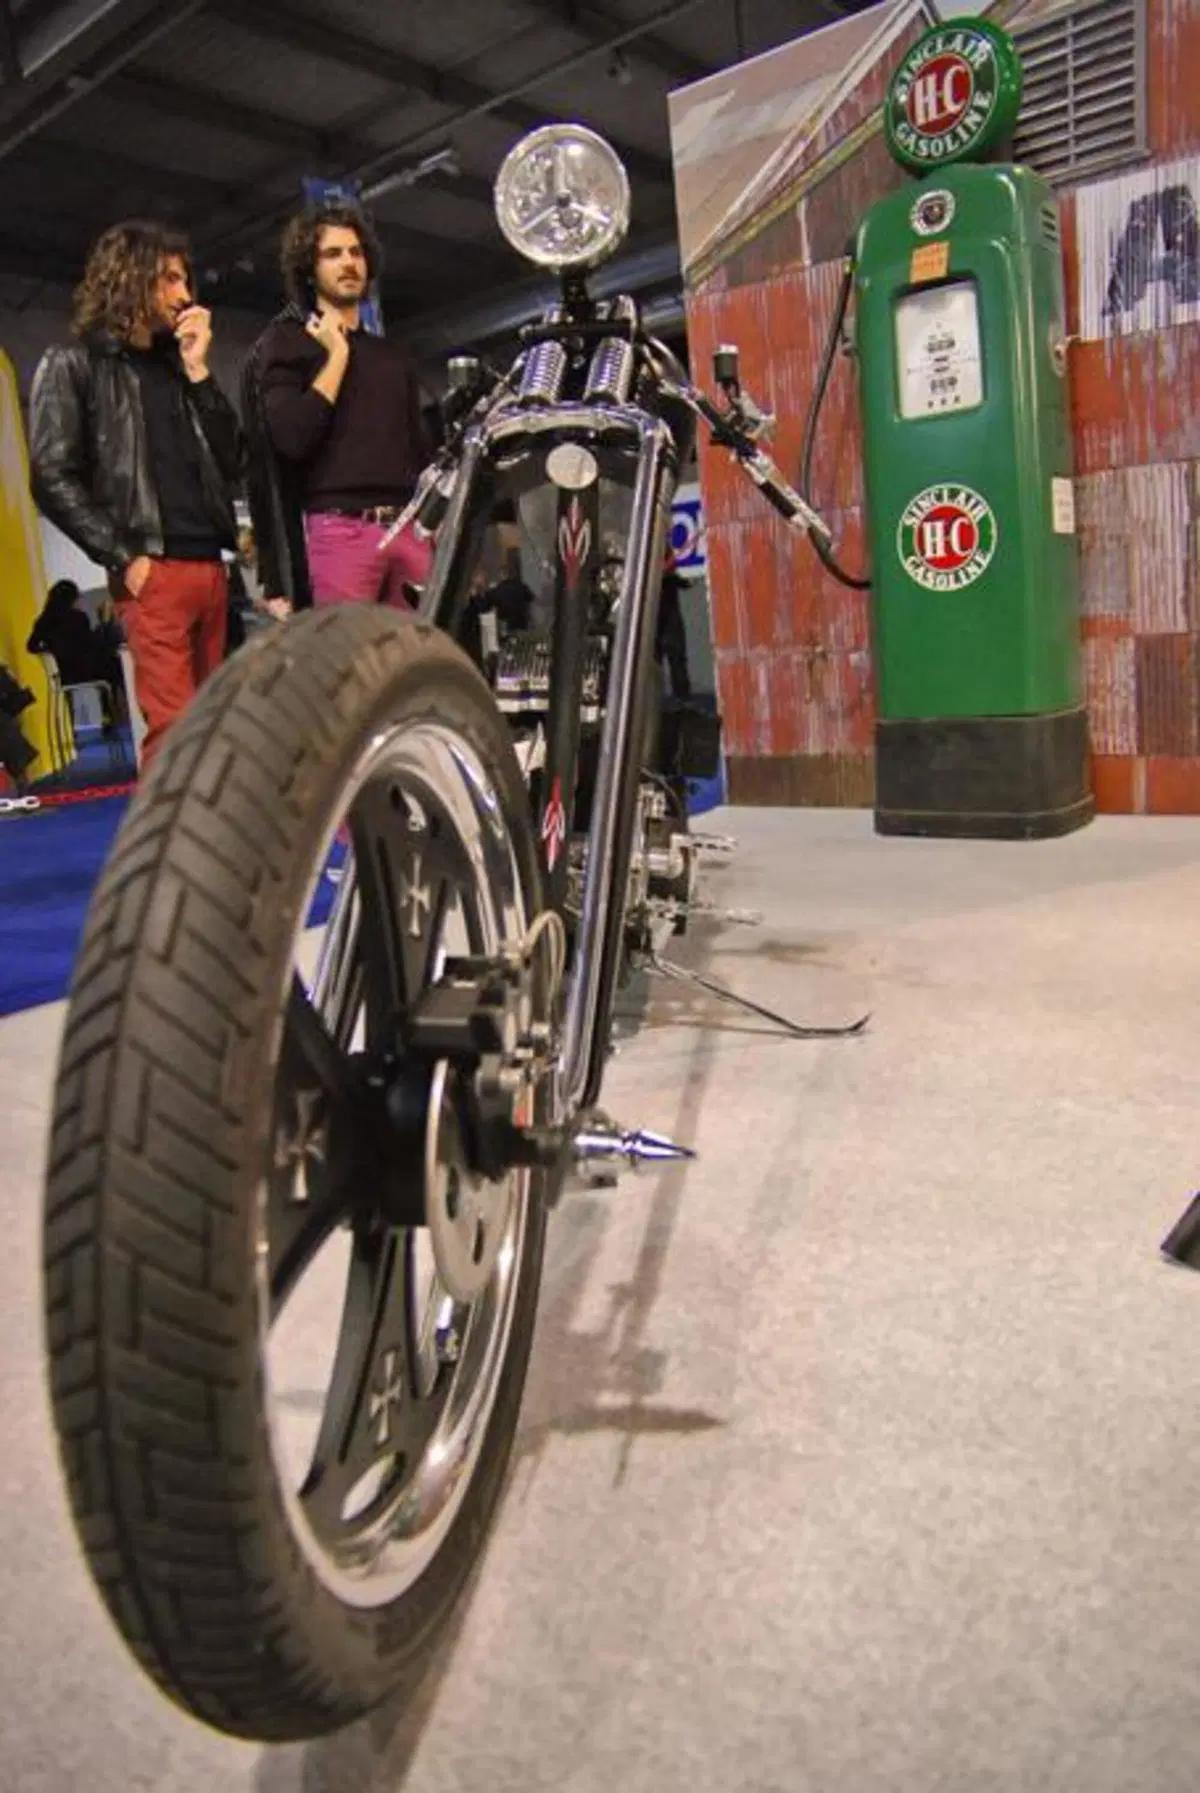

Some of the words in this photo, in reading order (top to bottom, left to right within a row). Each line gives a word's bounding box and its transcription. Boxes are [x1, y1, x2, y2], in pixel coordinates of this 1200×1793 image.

[895, 34, 992, 104] SINCLAIR
[896, 91, 992, 157] GASOLINE
[904, 487, 989, 528] SINCLAIR
[904, 548, 989, 589] GASOLINE
